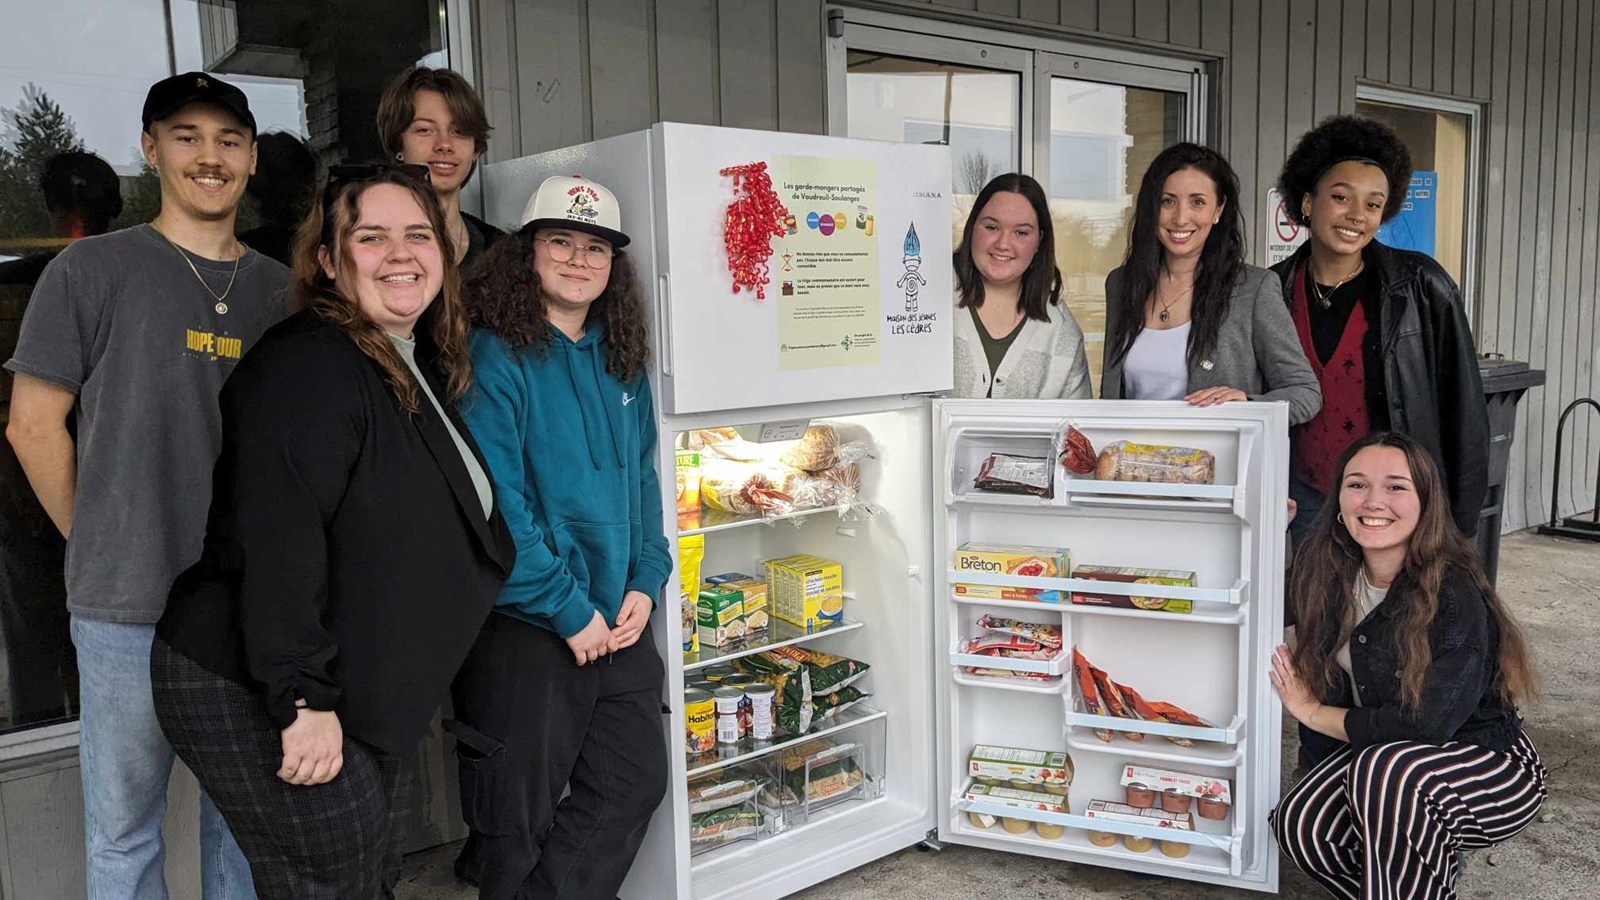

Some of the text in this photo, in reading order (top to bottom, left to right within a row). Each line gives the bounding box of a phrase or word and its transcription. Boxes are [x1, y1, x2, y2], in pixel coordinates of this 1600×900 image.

[567, 186, 585, 197] VANS
[783, 181, 866, 195] Les garde-mangers partagés
[800, 193, 860, 203] Vaudreuil-Soulanges
[187, 329, 214, 353] HOPE
[216, 336, 242, 359] OUR
[961, 556, 1002, 572] Breton
[781, 646, 806, 662] PRIM
